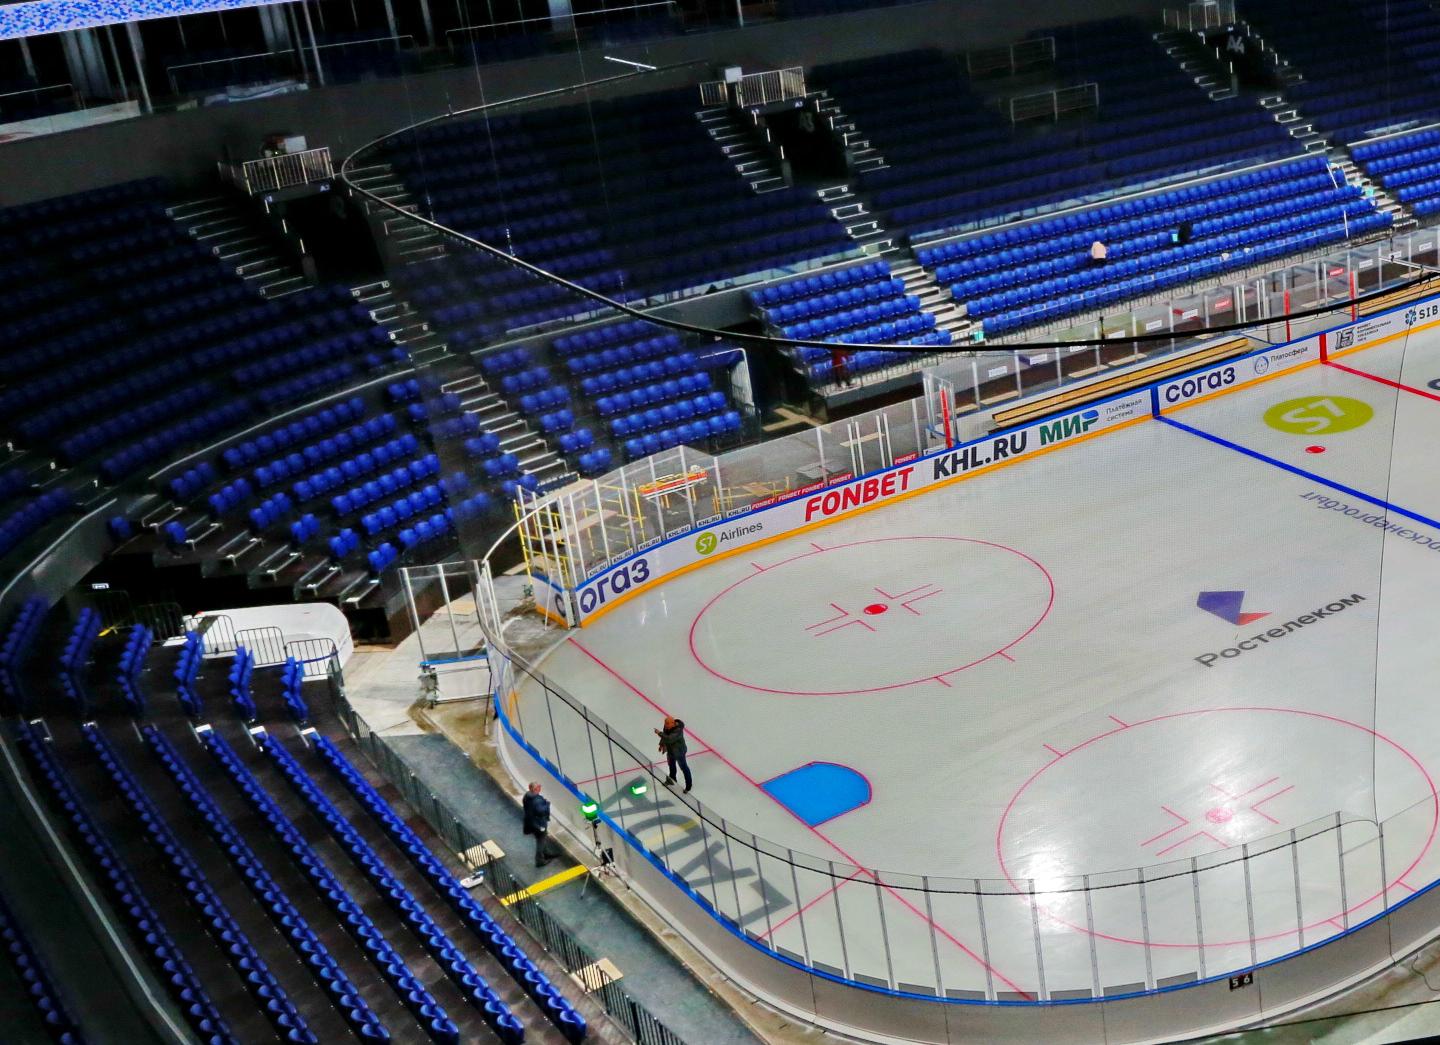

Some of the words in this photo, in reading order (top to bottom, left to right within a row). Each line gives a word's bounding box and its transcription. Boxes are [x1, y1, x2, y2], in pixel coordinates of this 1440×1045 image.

[1419, 304, 1439, 320] SIB
[1040, 410, 1099, 446] МИР
[933, 431, 1028, 480] KHL.RU
[805, 467, 914, 522] FONBET
[719, 521, 764, 543] Airlines
[1193, 593, 1367, 668] Ростелеком
